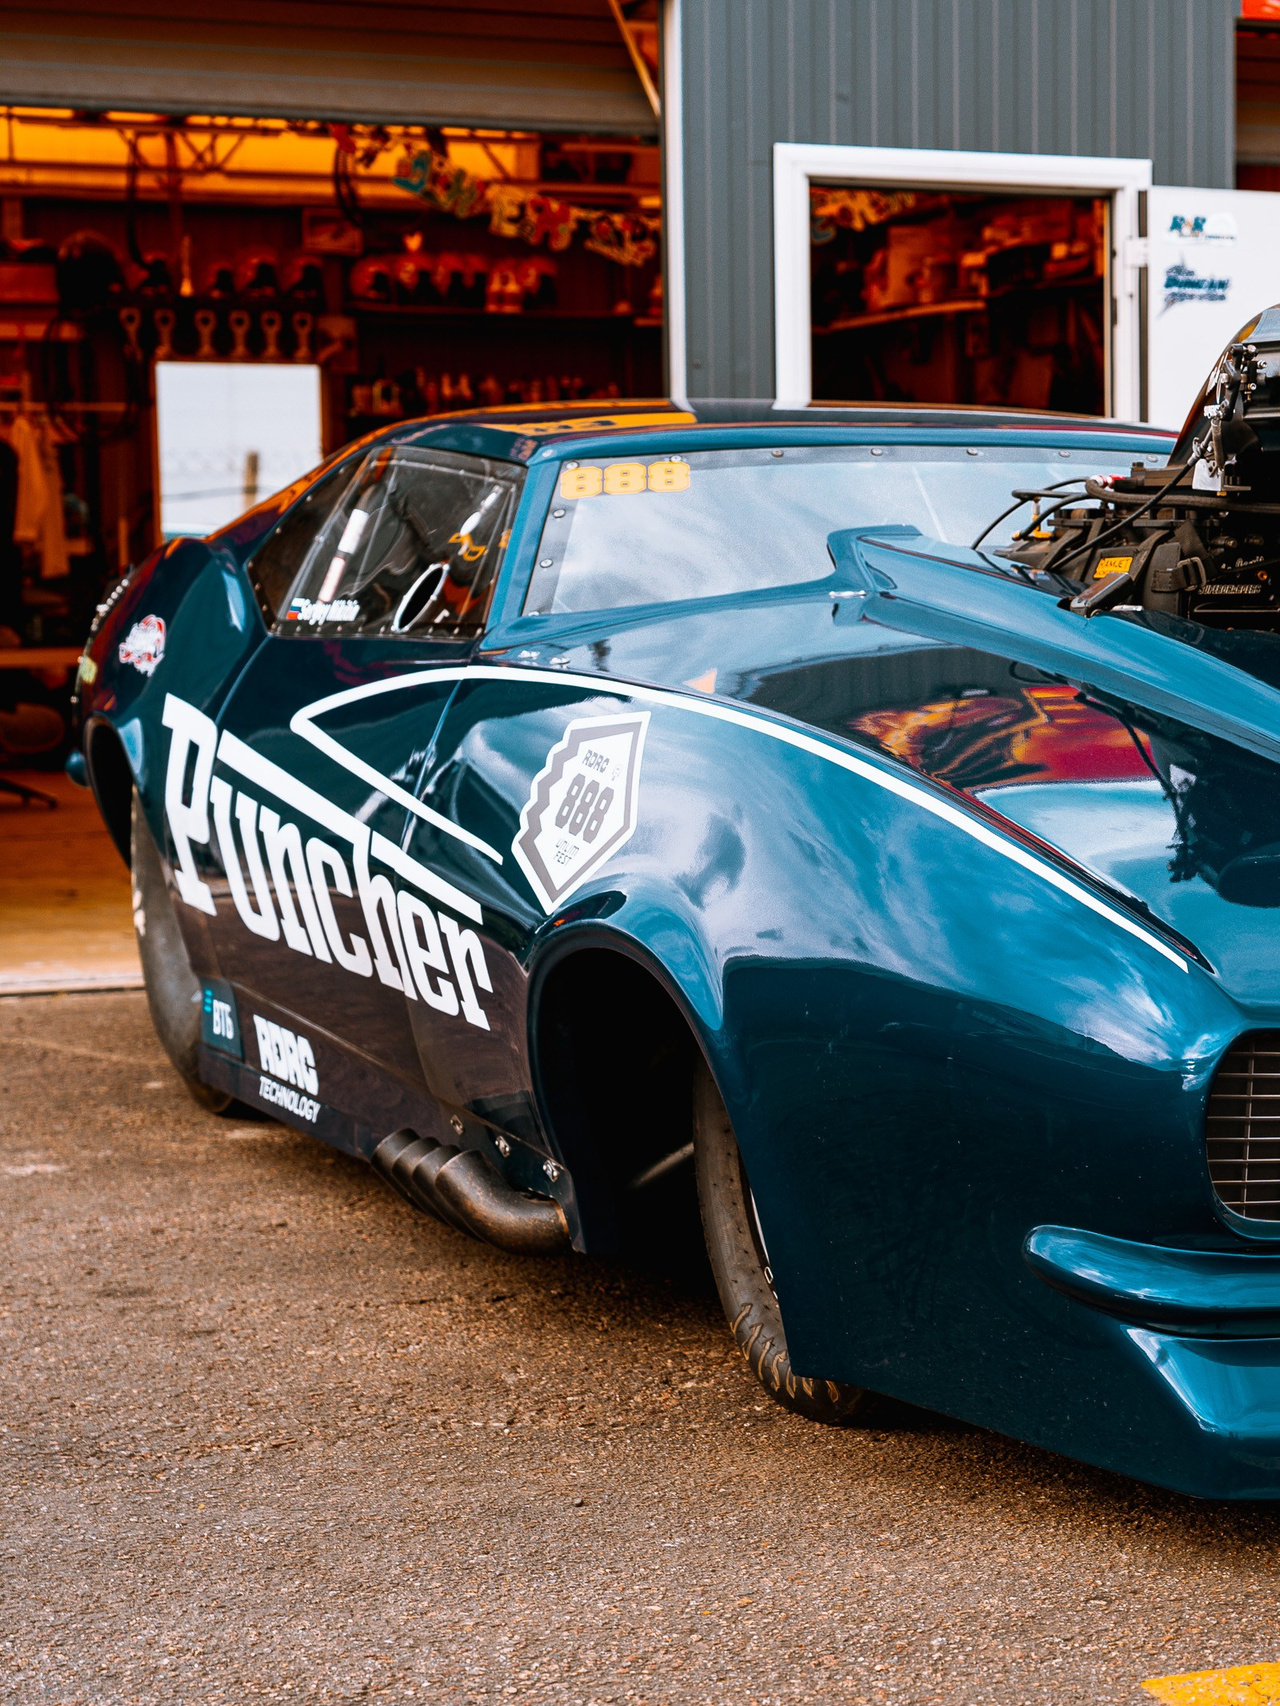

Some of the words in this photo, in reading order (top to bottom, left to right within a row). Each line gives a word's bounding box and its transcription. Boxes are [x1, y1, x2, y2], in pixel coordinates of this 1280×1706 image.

[560, 461, 691, 499] 888
[582, 749, 610, 774] RDRC
[555, 773, 614, 844] 888
[552, 850, 573, 867] FEST
[213, 999, 234, 1040] ВТБ
[253, 1014, 319, 1096] RDRC
[259, 1075, 321, 1124] TECHNOLOGY
